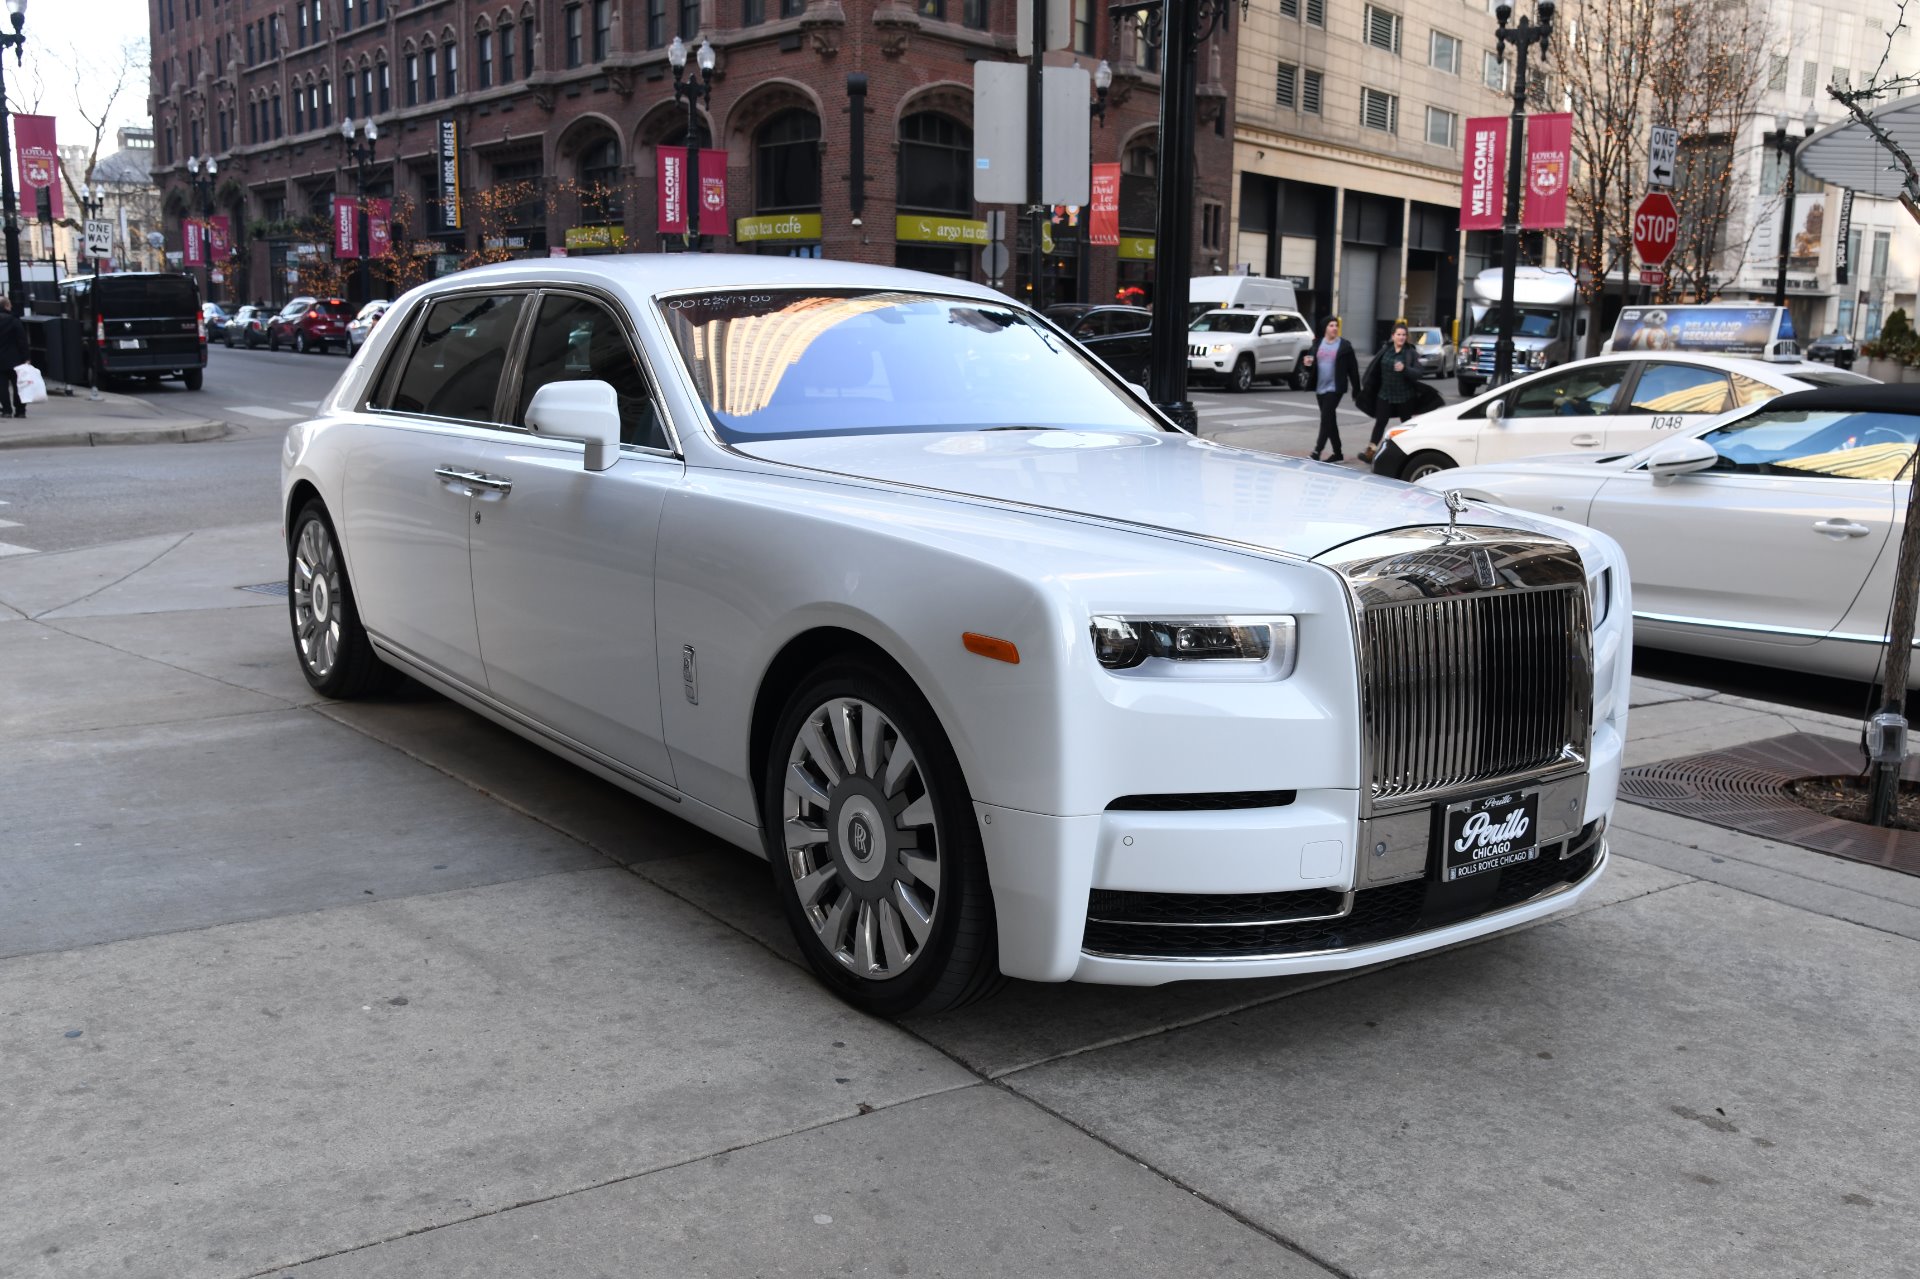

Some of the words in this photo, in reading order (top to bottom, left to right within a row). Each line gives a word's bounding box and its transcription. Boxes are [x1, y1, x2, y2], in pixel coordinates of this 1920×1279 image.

[443, 122, 454, 157] BAGELS
[1488, 131, 1496, 163] CAMPUS
[1654, 131, 1675, 148] ONE
[21, 148, 52, 156] LOYOLA
[1532, 152, 1564, 160] LOYOLA
[1652, 148, 1675, 162] WAY
[1471, 131, 1488, 216] WELCOME
[1486, 164, 1494, 190] TOWER
[665, 157, 674, 222] WELCOME
[446, 186, 456, 226] EINSTEIN
[1838, 189, 1852, 242] ORDSTROM
[88, 223, 110, 234] ONE
[340, 205, 349, 250] WELCOME
[776, 216, 801, 233] café
[937, 226, 960, 240] argo
[963, 225, 975, 238] tea
[1635, 214, 1676, 243] STOP
[88, 234, 110, 243] WAY
[1719, 321, 1742, 331] AND
[1651, 416, 1683, 430] 1048
[1481, 794, 1513, 810] Perillo
[1454, 807, 1530, 853] Perillo
[1472, 841, 1511, 860] CHICAGO
[1458, 864, 1477, 877] ROLLS
[1478, 858, 1499, 871] ROYCE
[1499, 851, 1527, 866] CHICAGO
